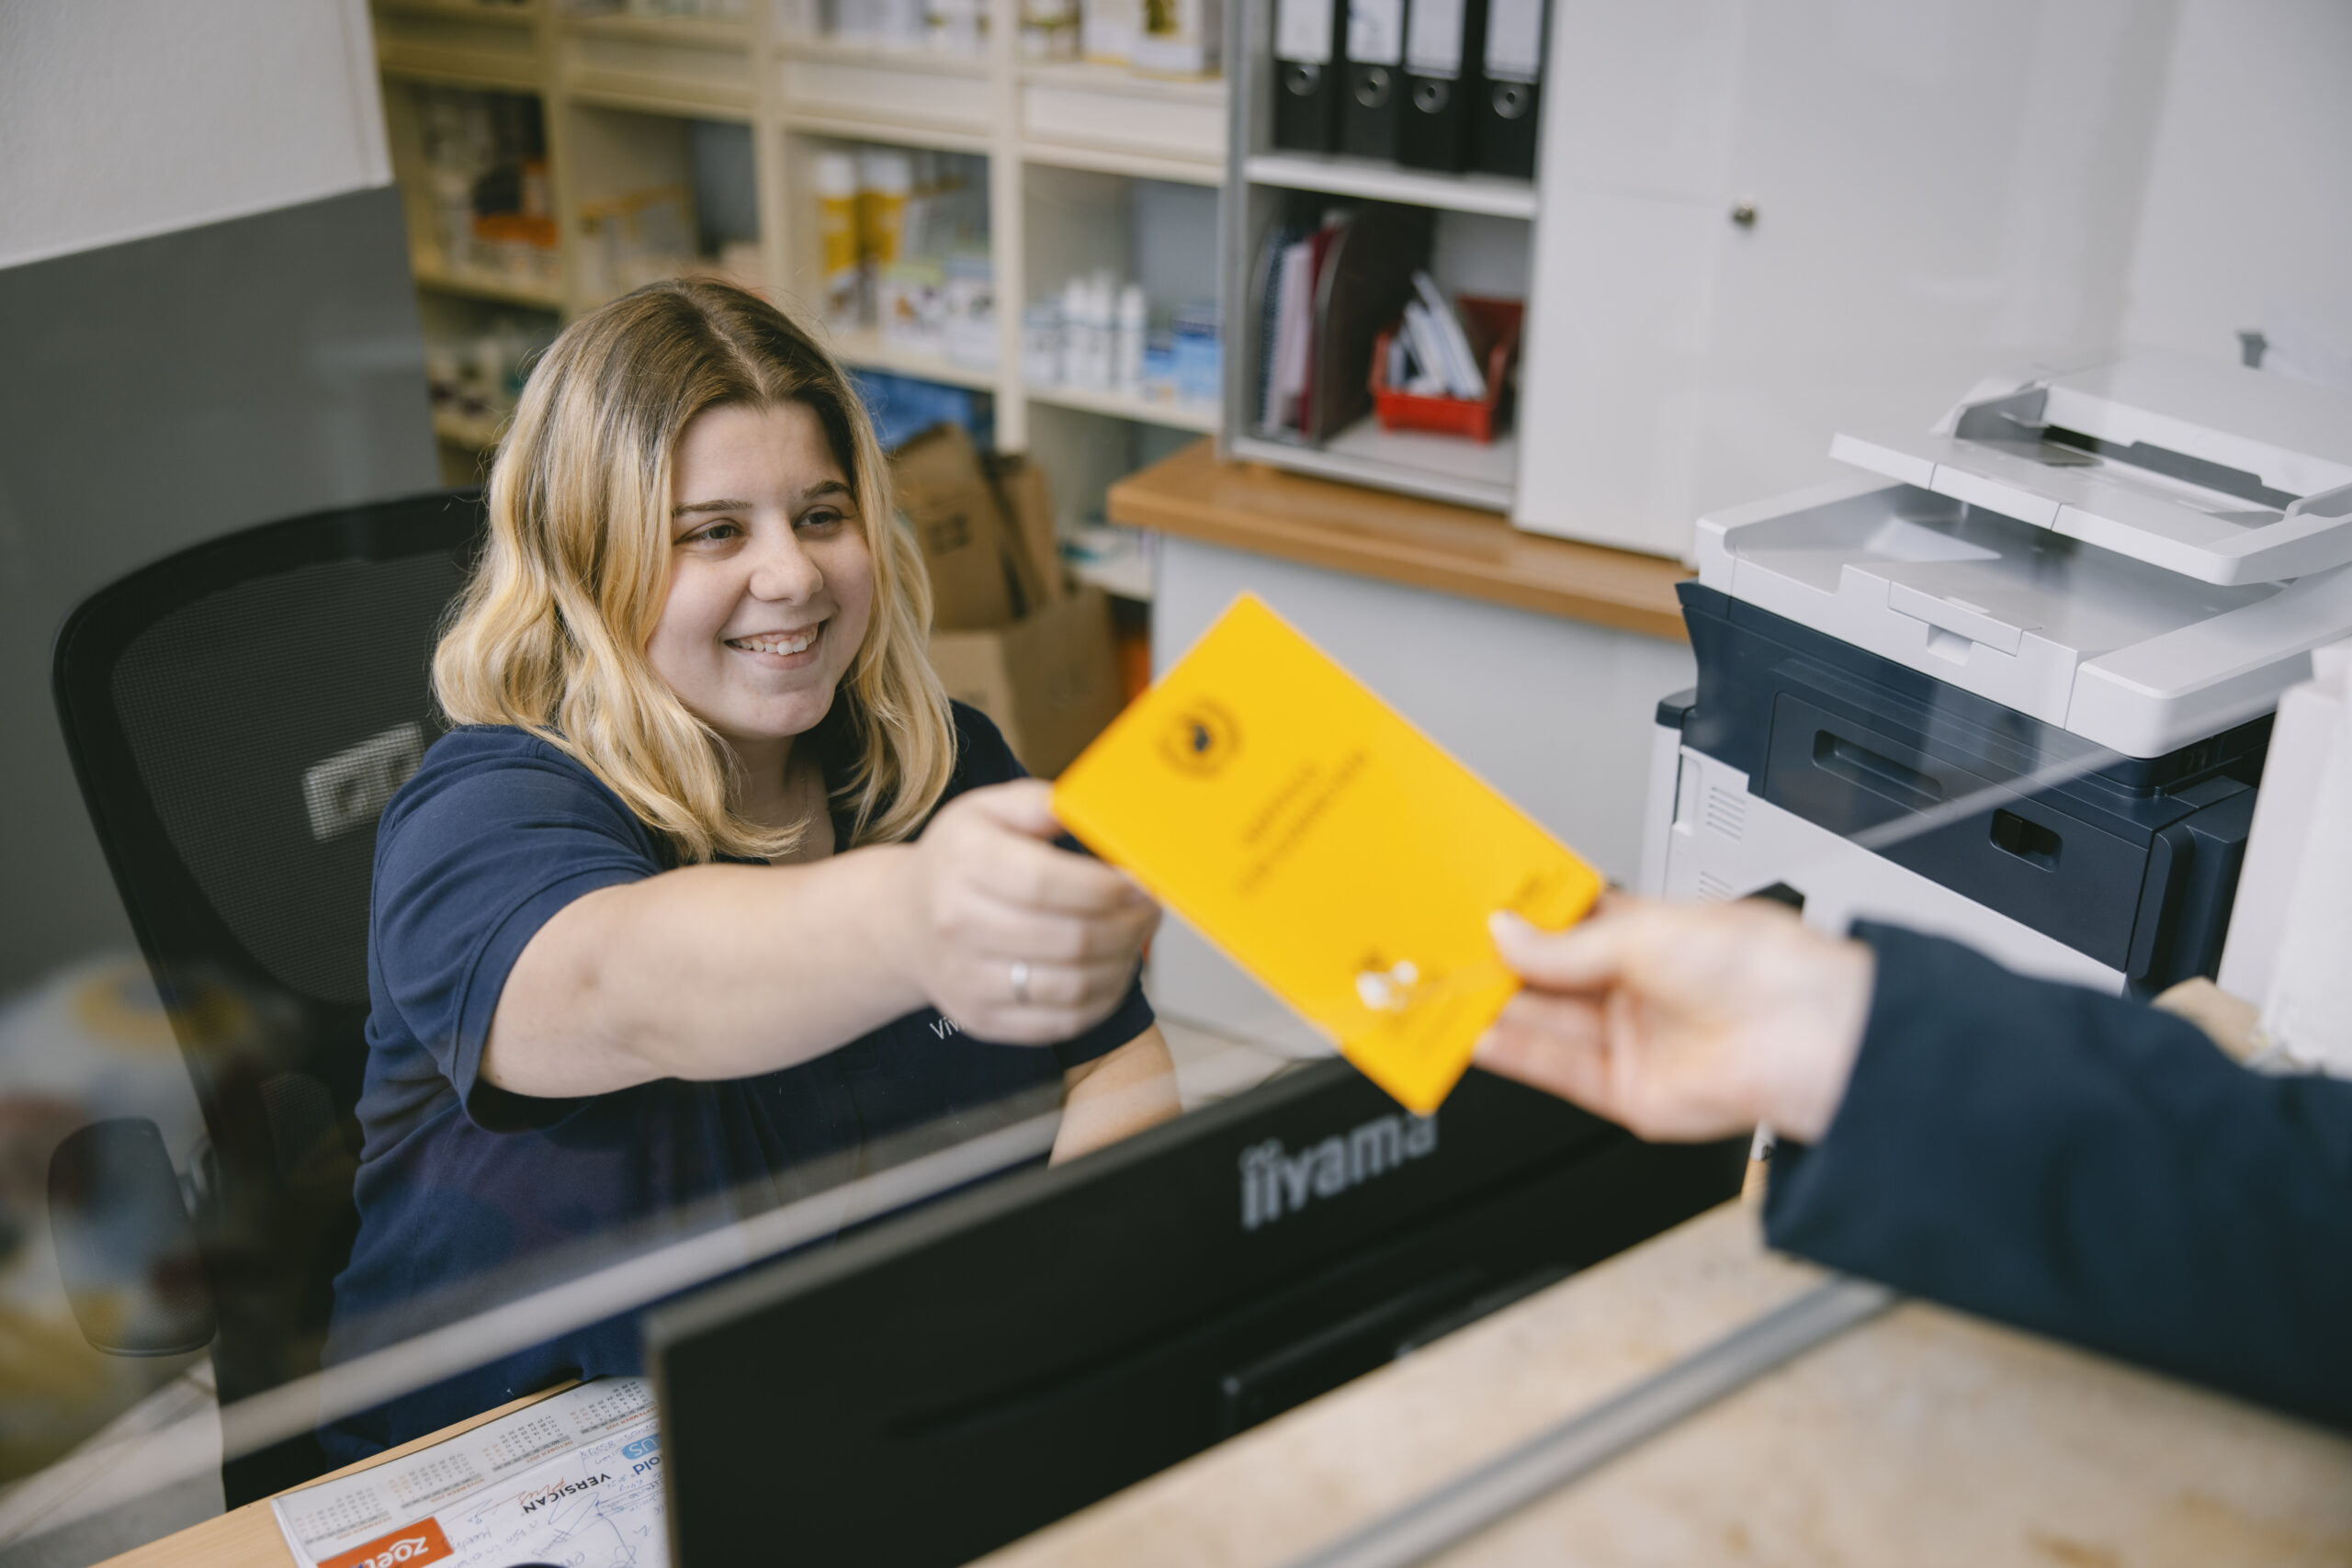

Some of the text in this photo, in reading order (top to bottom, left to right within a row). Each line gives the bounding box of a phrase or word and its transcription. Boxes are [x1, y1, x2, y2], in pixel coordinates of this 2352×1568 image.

[632, 1454, 662, 1475] old
[522, 1472, 611, 1514] VERSICAN
[351, 1536, 428, 1568] zoet
